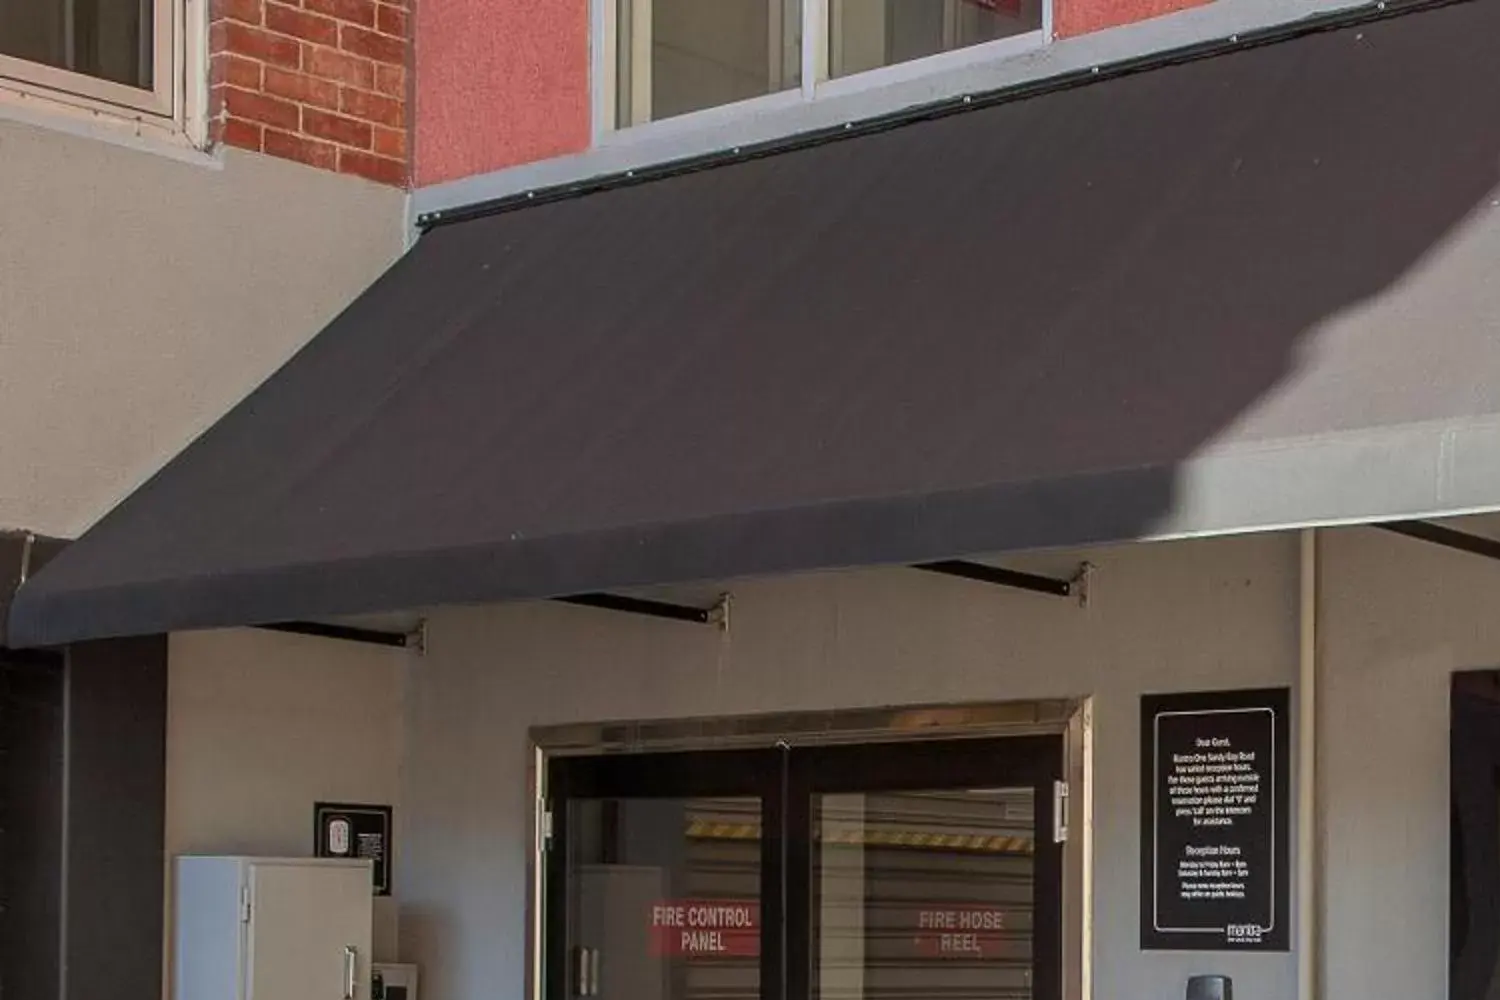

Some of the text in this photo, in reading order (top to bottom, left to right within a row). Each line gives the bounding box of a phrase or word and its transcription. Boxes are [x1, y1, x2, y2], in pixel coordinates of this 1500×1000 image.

[653, 906, 753, 928] FIRE CONTROL
[920, 910, 1004, 930] FIRE HOSE
[680, 930, 726, 952] PANEL
[940, 933, 982, 953] REEL
